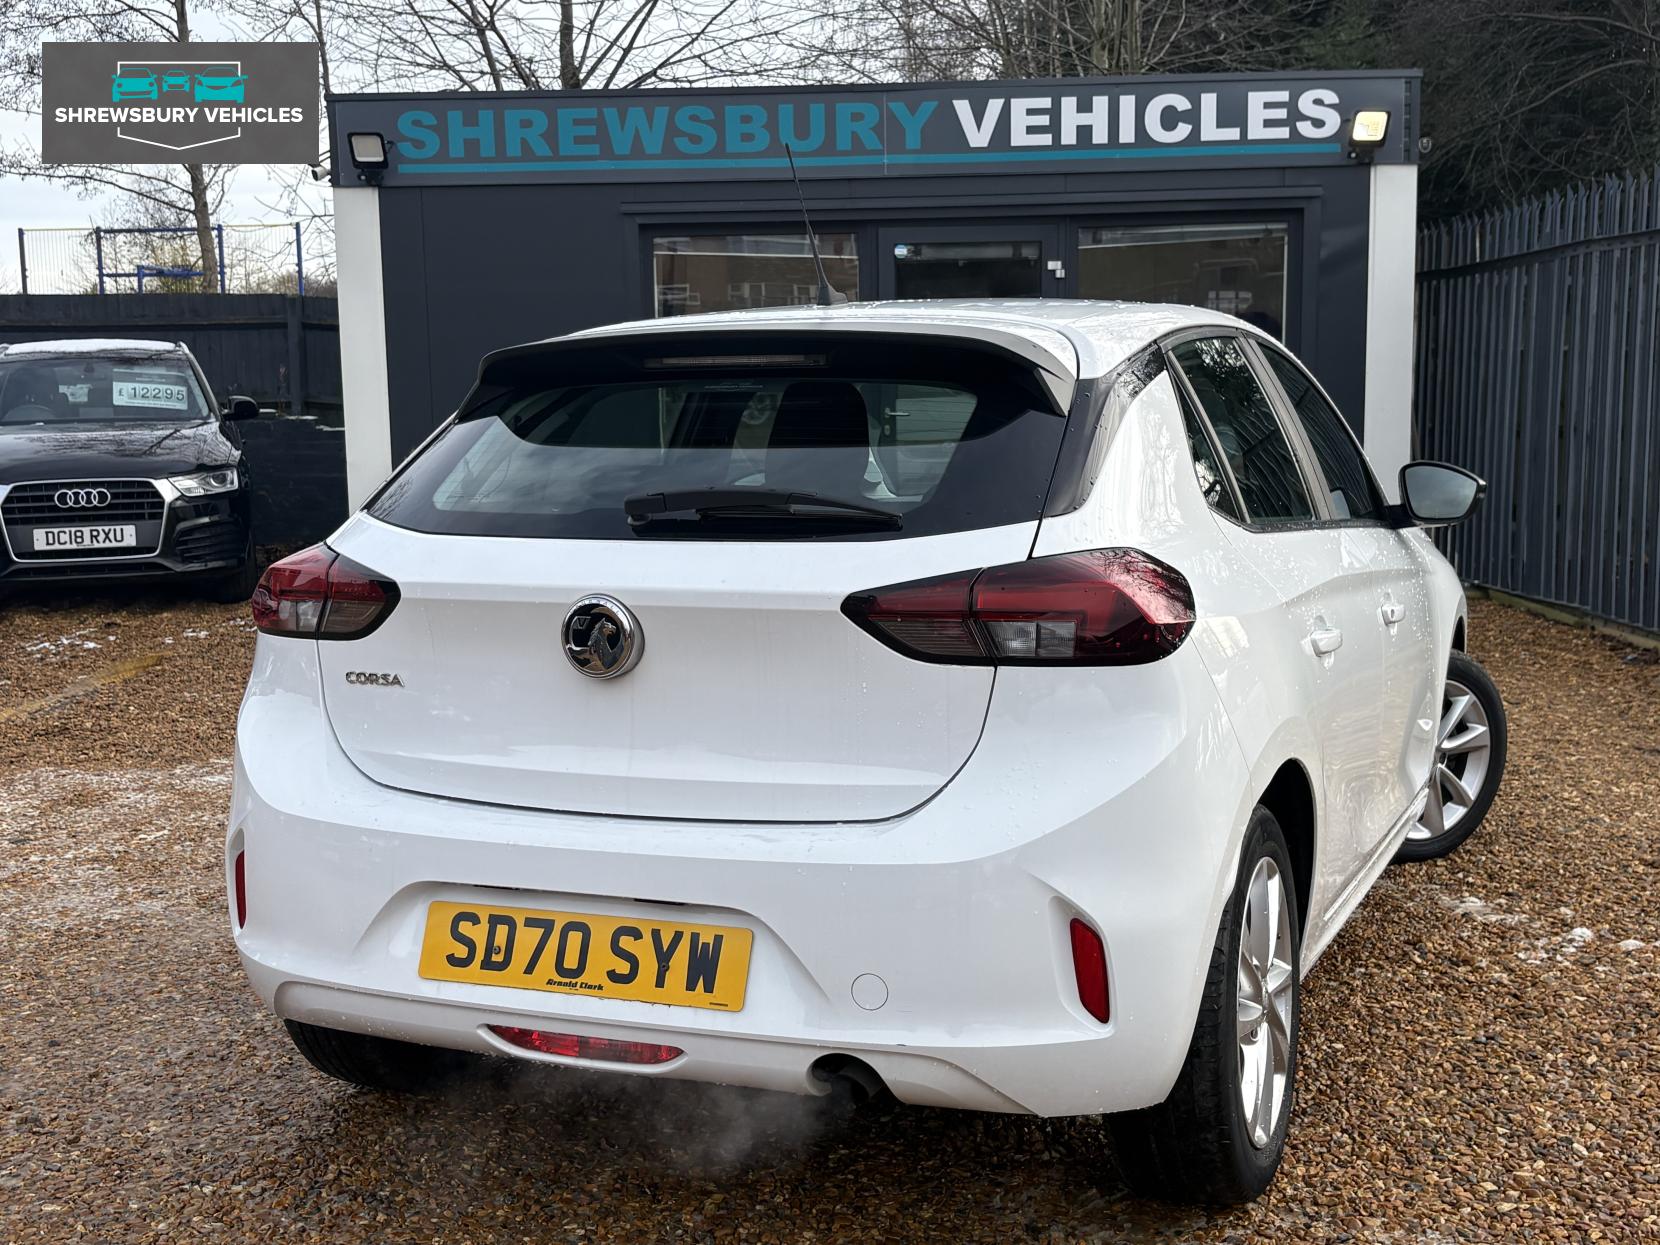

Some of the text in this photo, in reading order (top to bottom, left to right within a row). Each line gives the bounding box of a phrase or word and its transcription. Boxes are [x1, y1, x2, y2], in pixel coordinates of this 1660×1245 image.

[396, 88, 1342, 159] SHREWSBURY VEHICLES
[118, 386, 185, 402] £ 12295
[45, 529, 85, 546] DC18
[89, 527, 125, 544] RXU
[345, 671, 406, 688] CORSA
[445, 911, 724, 994] SD70 SYW
[546, 978, 579, 988] Arnold
[579, 981, 604, 991] Clark
